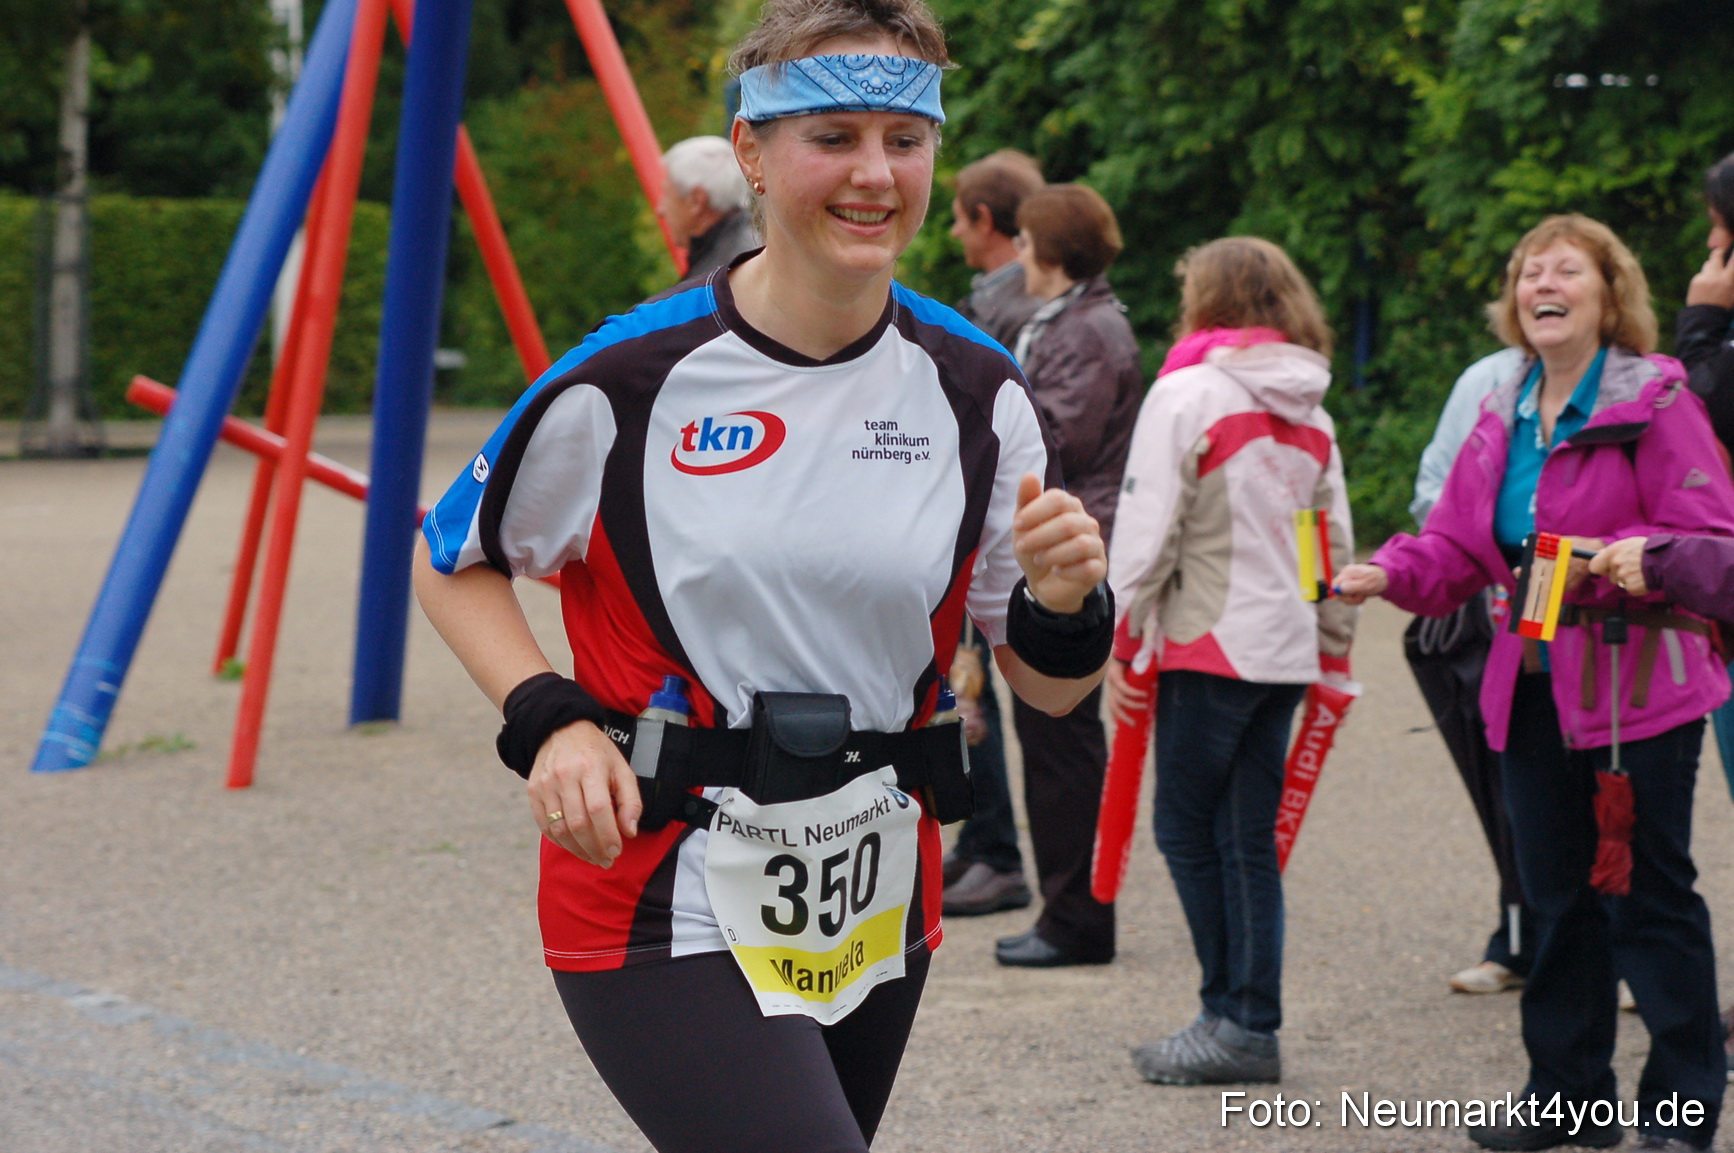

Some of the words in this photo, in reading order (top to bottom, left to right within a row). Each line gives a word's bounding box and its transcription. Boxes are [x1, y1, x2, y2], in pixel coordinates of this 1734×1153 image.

[680, 417, 753, 452] tkn
[864, 420, 898, 431] team
[875, 433, 930, 447] klinikum
[852, 448, 912, 464] nürnberg
[914, 452, 931, 461] e.V.
[1294, 703, 1337, 782] Audi
[716, 811, 798, 847] PARTL
[804, 796, 891, 846] Neumarkt
[1274, 788, 1308, 853] BKK
[760, 831, 881, 937] 350
[769, 940, 864, 993] Manuela
